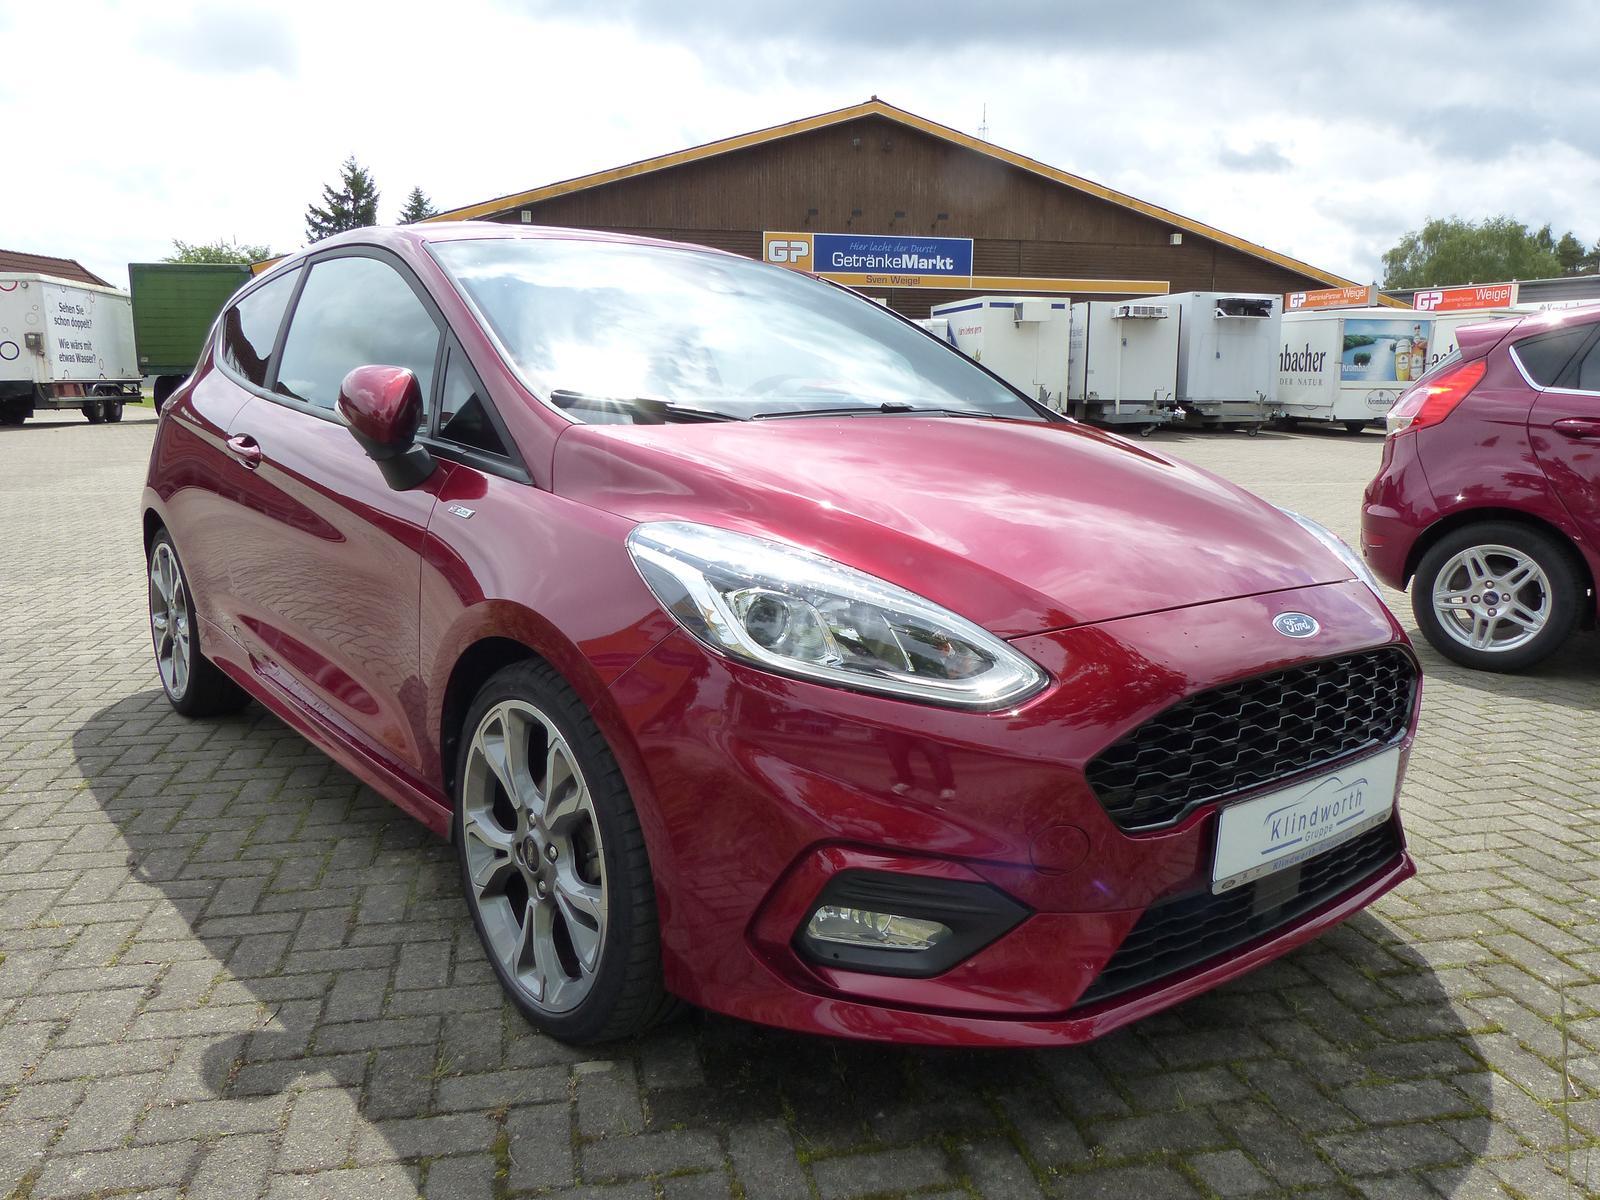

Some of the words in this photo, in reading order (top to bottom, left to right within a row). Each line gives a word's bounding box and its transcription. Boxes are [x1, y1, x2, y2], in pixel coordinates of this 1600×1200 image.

[768, 240, 809, 263] GP
[849, 242, 866, 251] Hier
[869, 241, 891, 252] lacht
[894, 243, 908, 252] der
[910, 244, 937, 254] Durst!
[832, 252, 954, 270] GetränkeMarkt
[866, 275, 888, 284] Sven
[890, 276, 921, 286] Weigel
[1342, 288, 1367, 300] Weigel
[1416, 291, 1443, 310] GP
[1475, 286, 1511, 302] Weigel
[58, 302, 75, 314] Sehen
[75, 304, 85, 315] Sie
[54, 316, 71, 327] schon
[71, 317, 93, 331] doppelt?
[58, 337, 70, 349] Wie
[59, 352, 76, 363] etwas
[75, 353, 97, 364] Wasser?
[1279, 377, 1293, 386] DER
[1298, 378, 1324, 386] NATUR
[1283, 617, 1311, 633] Ford
[1270, 788, 1363, 841] Klindworth
[1304, 824, 1334, 842] Gruppe
